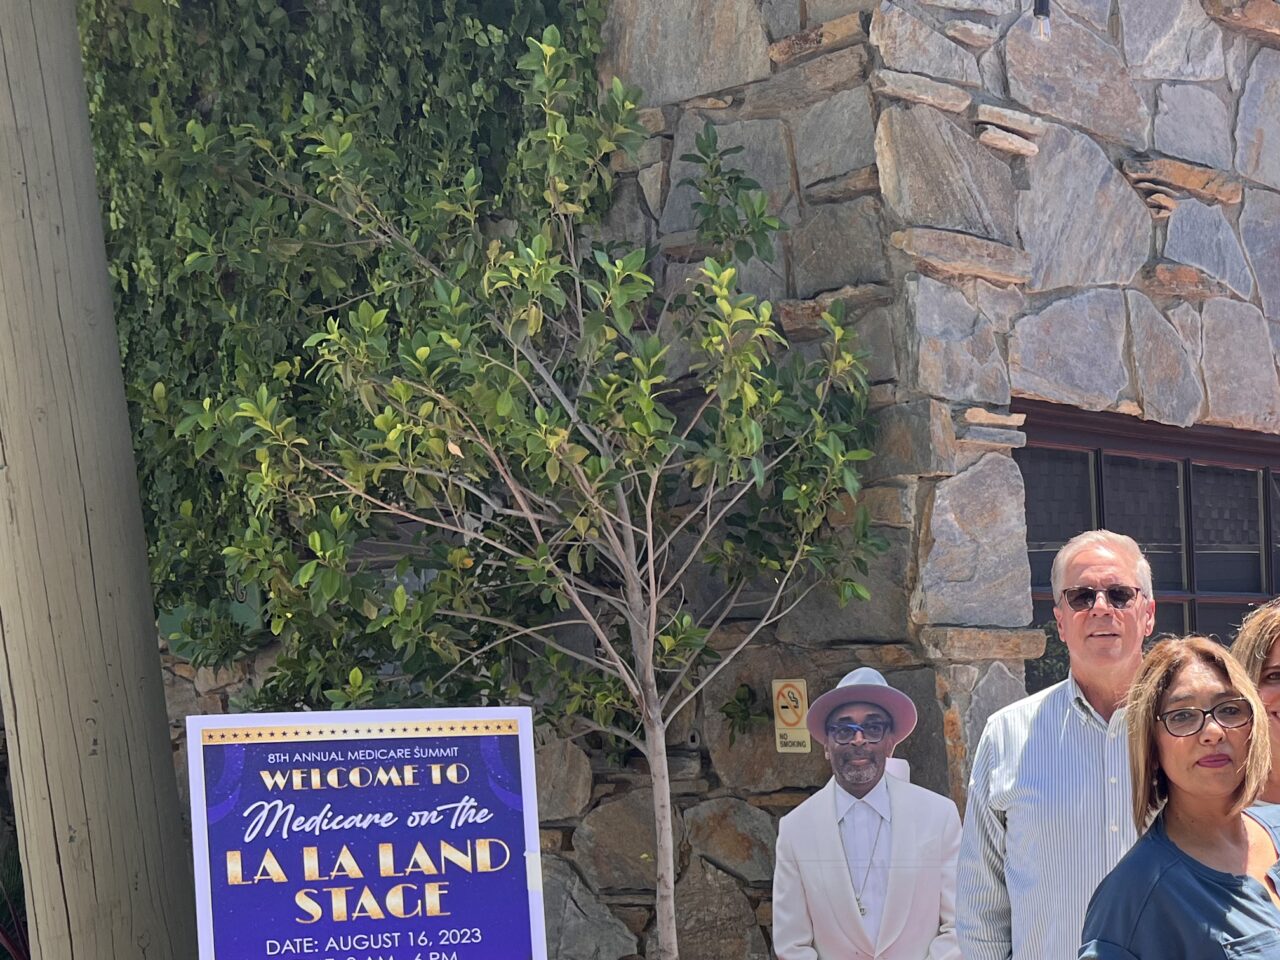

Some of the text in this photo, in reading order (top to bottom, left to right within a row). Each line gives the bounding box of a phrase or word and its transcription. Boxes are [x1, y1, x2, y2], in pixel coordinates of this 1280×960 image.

[267, 747, 459, 764] 8TH ANNUAL MEDICARE SUMMIT
[780, 740, 807, 748] SMOKING
[259, 763, 470, 791] WELCOME TO
[243, 795, 494, 843] Medicare on the
[226, 838, 511, 885] LA LA LAND
[295, 882, 451, 923] STAGE
[266, 928, 483, 955] DATE: AUGUST 16, 2023
